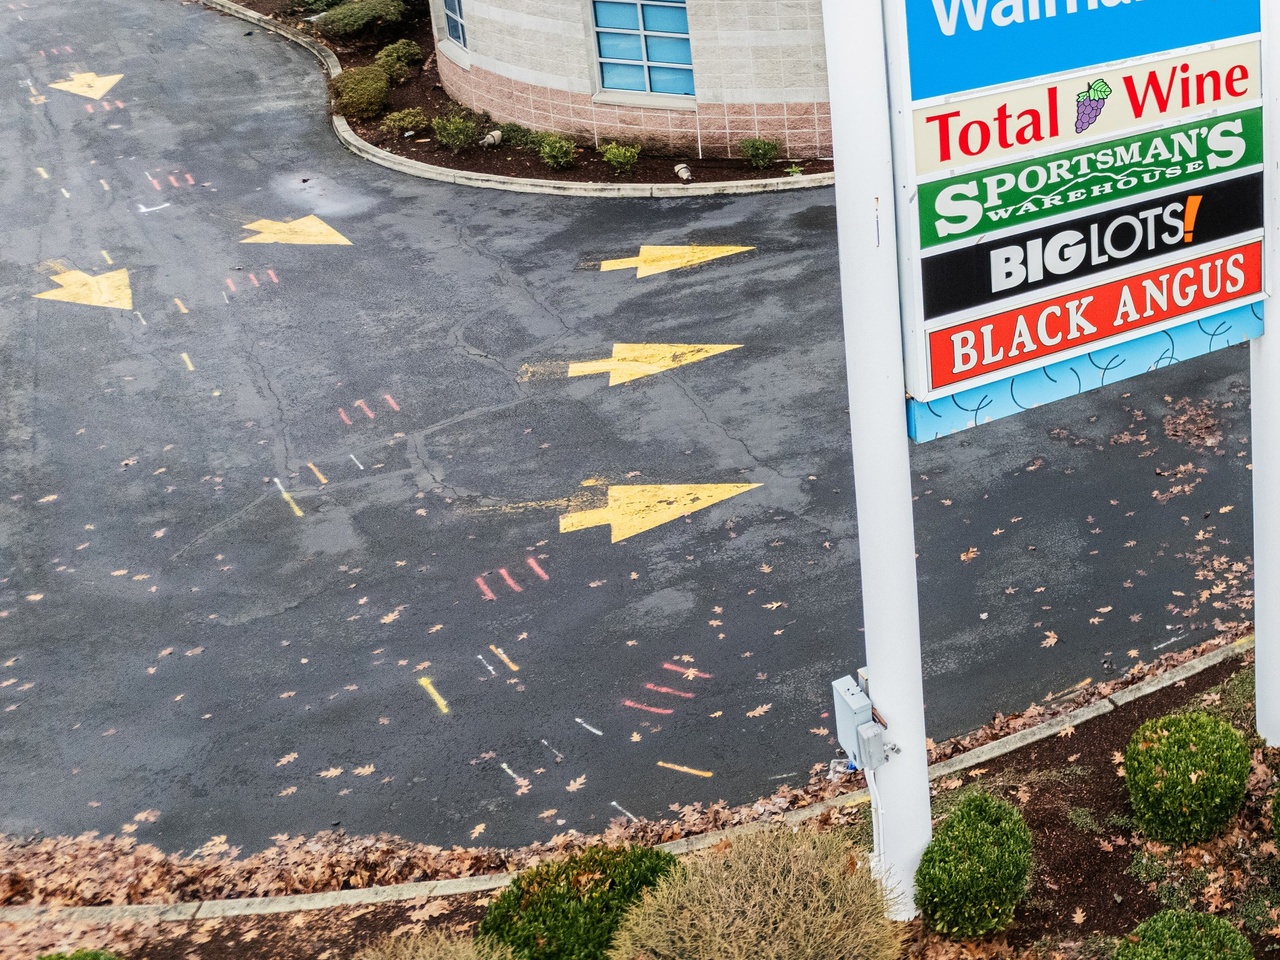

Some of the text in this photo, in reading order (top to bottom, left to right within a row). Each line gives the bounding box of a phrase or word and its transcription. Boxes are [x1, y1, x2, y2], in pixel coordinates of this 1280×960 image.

[926, 63, 1249, 162] Total Wine
[985, 160, 1204, 222] WAREHOUSE
[950, 253, 1246, 375] BLACK ANGUS
